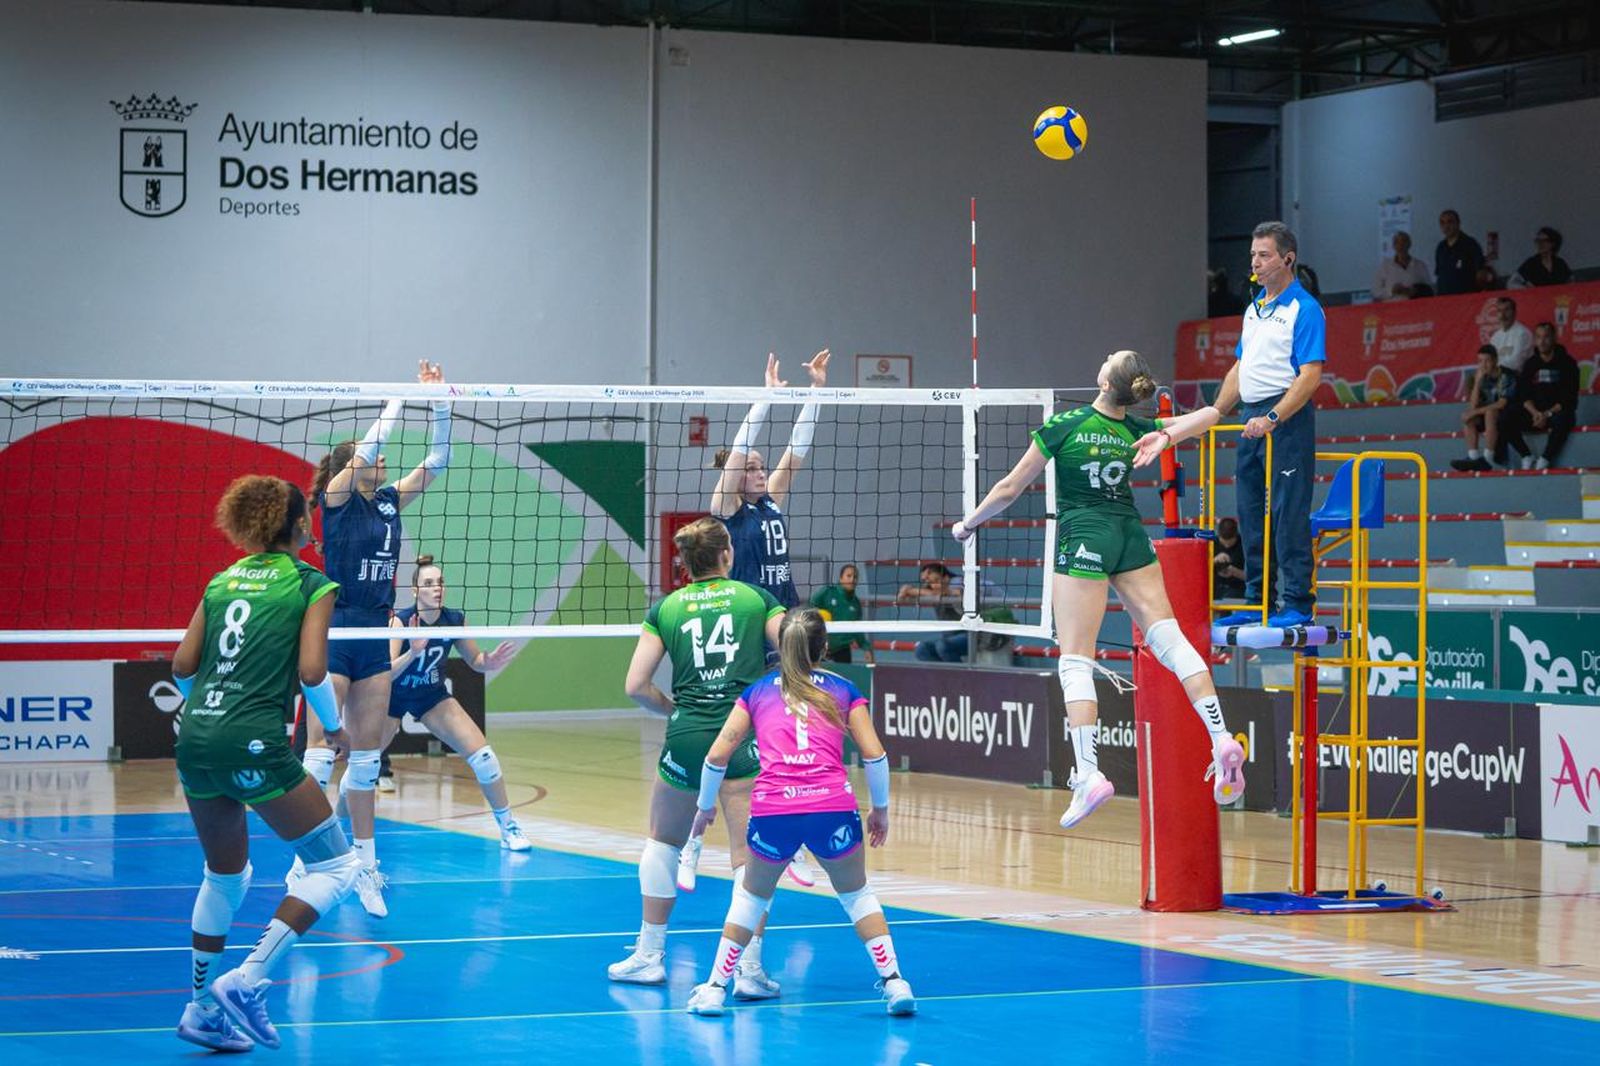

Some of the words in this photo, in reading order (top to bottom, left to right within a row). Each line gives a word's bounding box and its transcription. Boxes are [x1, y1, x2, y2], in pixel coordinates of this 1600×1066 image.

[218, 113, 430, 150] Ayuntamiento
[440, 121, 478, 150] de
[219, 157, 289, 190] Dos
[301, 159, 478, 195] Hermanas
[219, 198, 300, 218] Deportes
[39, 383, 65, 391] Volleyball
[67, 383, 94, 391] Challenge
[943, 391, 961, 399] CEV
[761, 519, 787, 556] 18
[680, 587, 736, 602] HERMAN
[219, 599, 251, 658] 8
[680, 613, 740, 668] 14
[216, 660, 238, 675] WAY
[699, 665, 729, 681] WAY
[884, 693, 1034, 756] EuroVolley.TV
[0, 734, 90, 750] CHAPA
[783, 753, 816, 765] WAY
